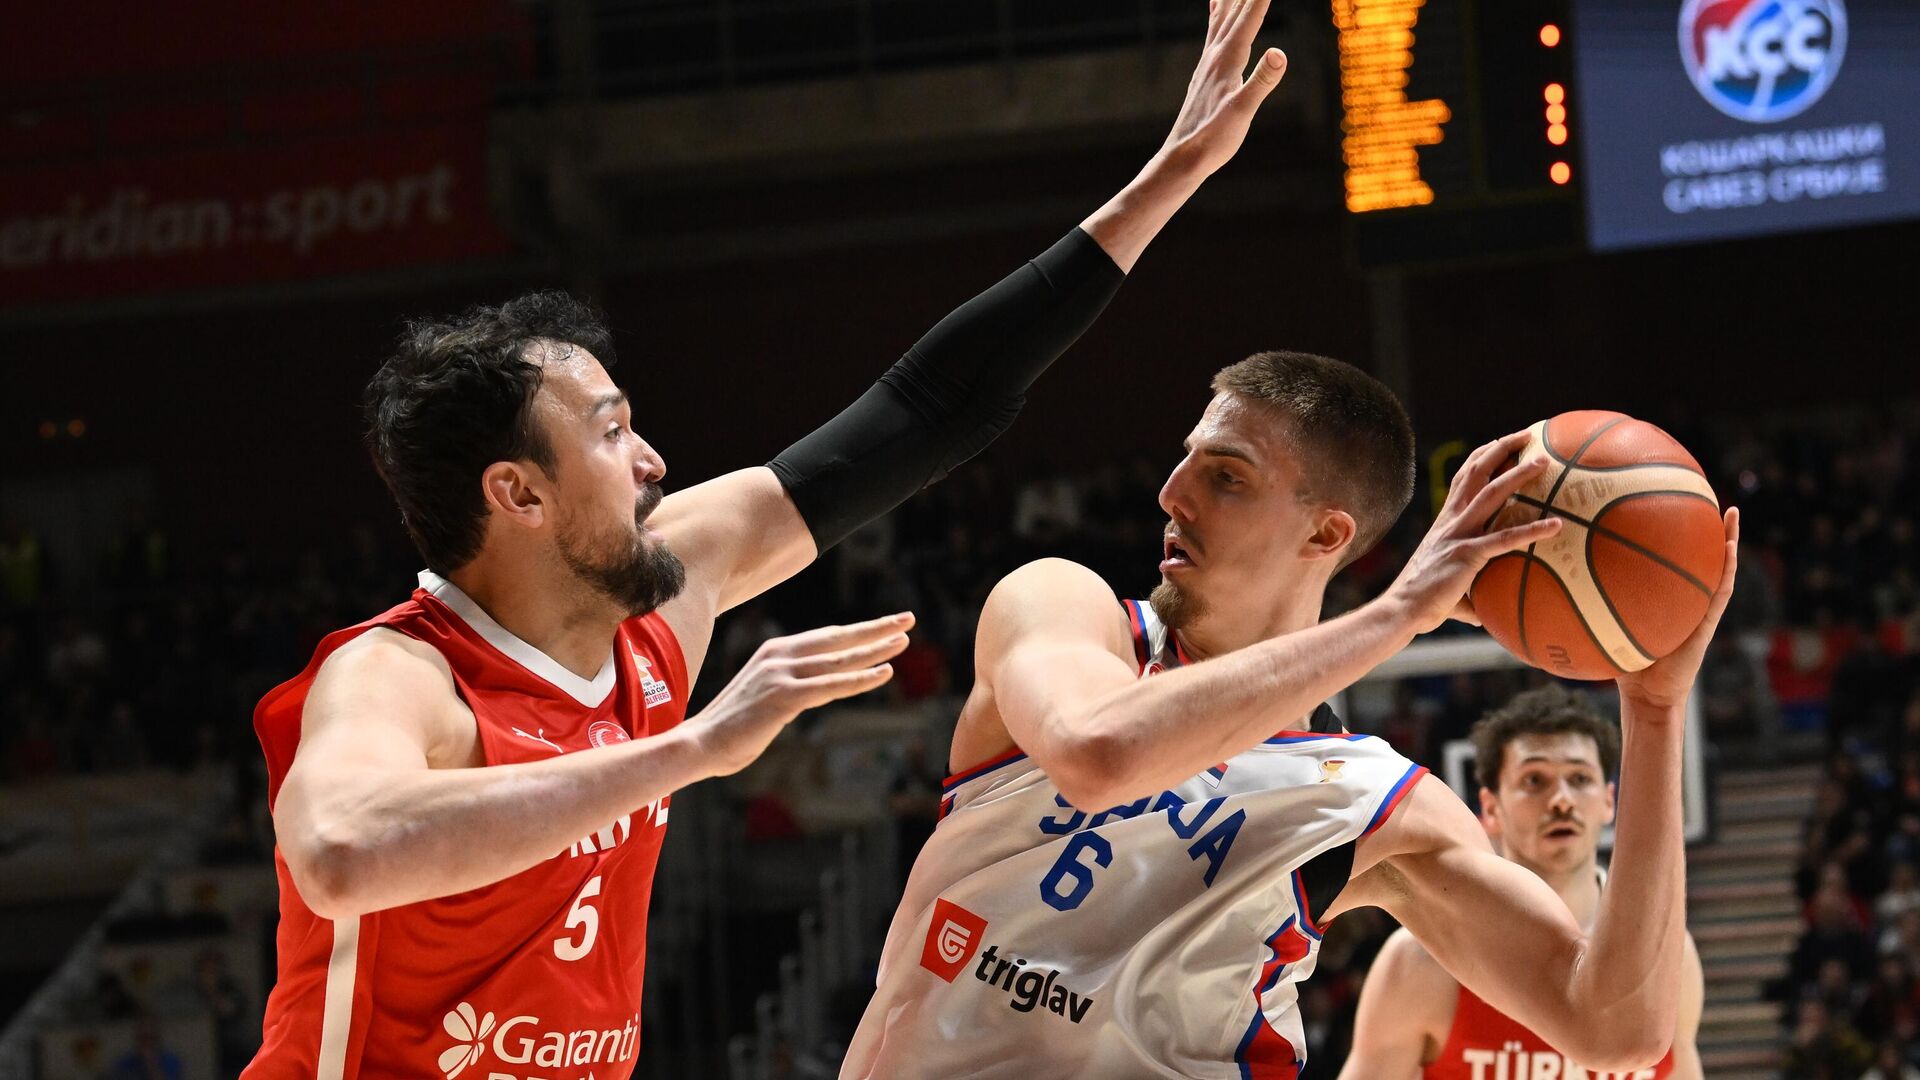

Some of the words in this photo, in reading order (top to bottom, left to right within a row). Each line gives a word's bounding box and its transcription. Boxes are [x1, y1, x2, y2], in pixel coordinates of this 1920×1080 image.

[1662, 171, 1767, 213] САВЕЗ
[1039, 830, 1113, 912] 6
[553, 875, 602, 962] 5
[974, 945, 1094, 1024] triglav
[492, 1012, 639, 1068] Garanti
